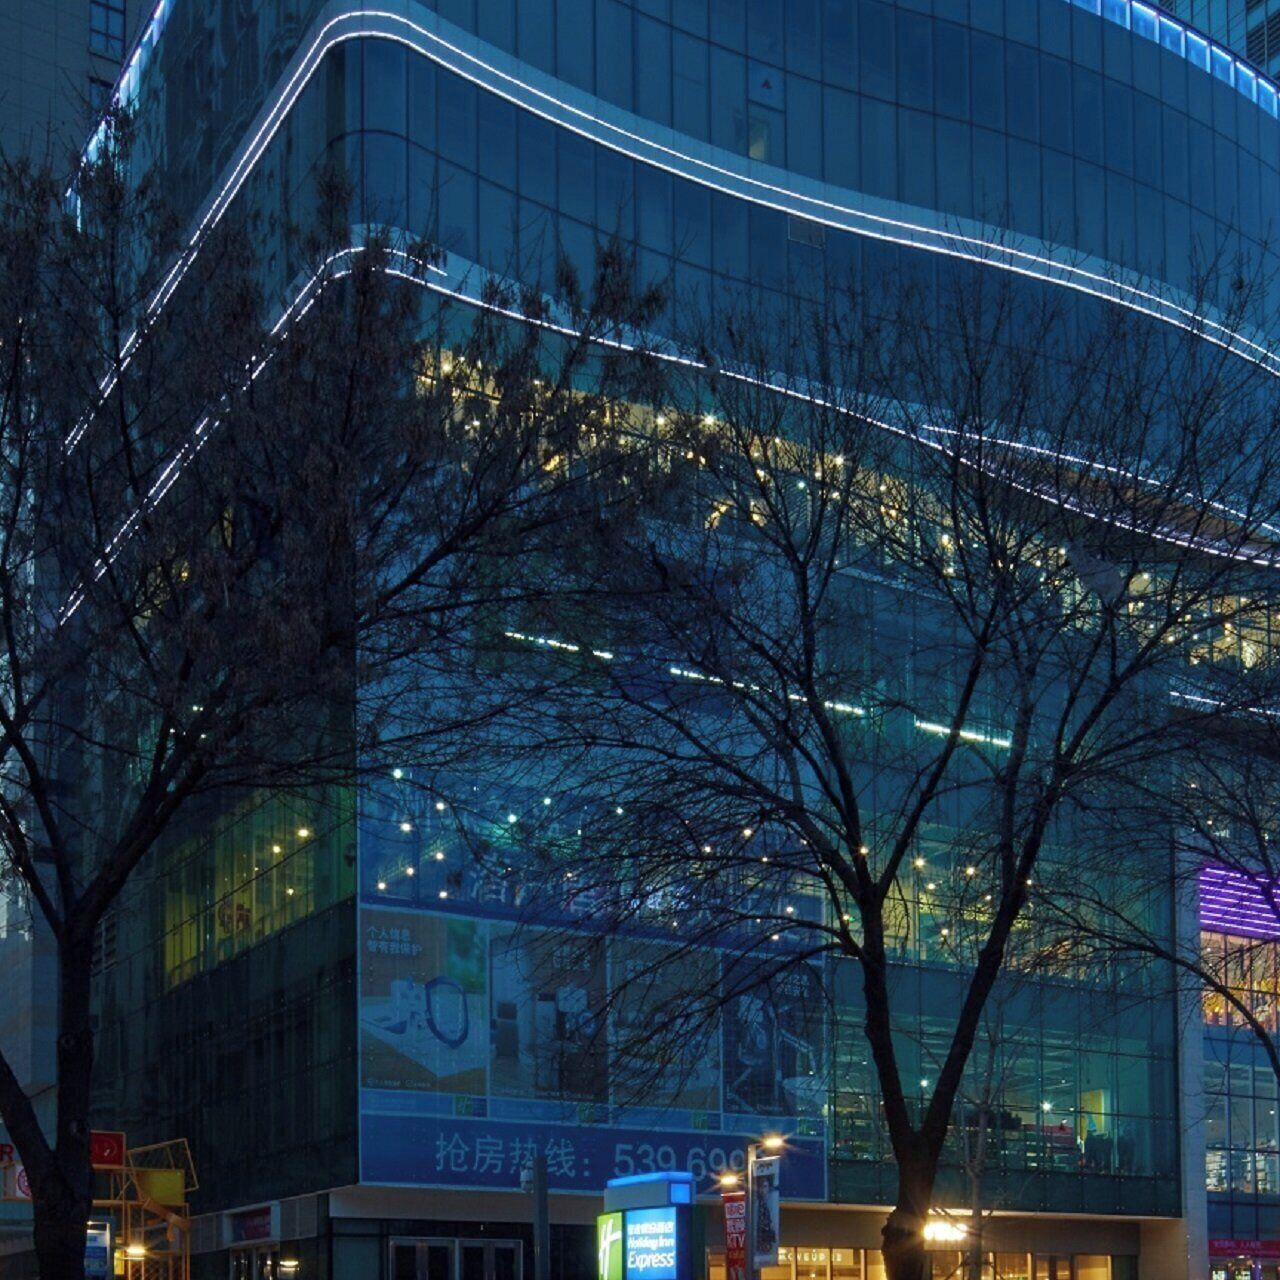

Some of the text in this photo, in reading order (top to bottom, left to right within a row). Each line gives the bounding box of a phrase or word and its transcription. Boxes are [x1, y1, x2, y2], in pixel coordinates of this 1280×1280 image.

[686, 1146, 762, 1182] 699
[659, 1235, 674, 1247] Inn
[628, 1251, 675, 1272] Express
